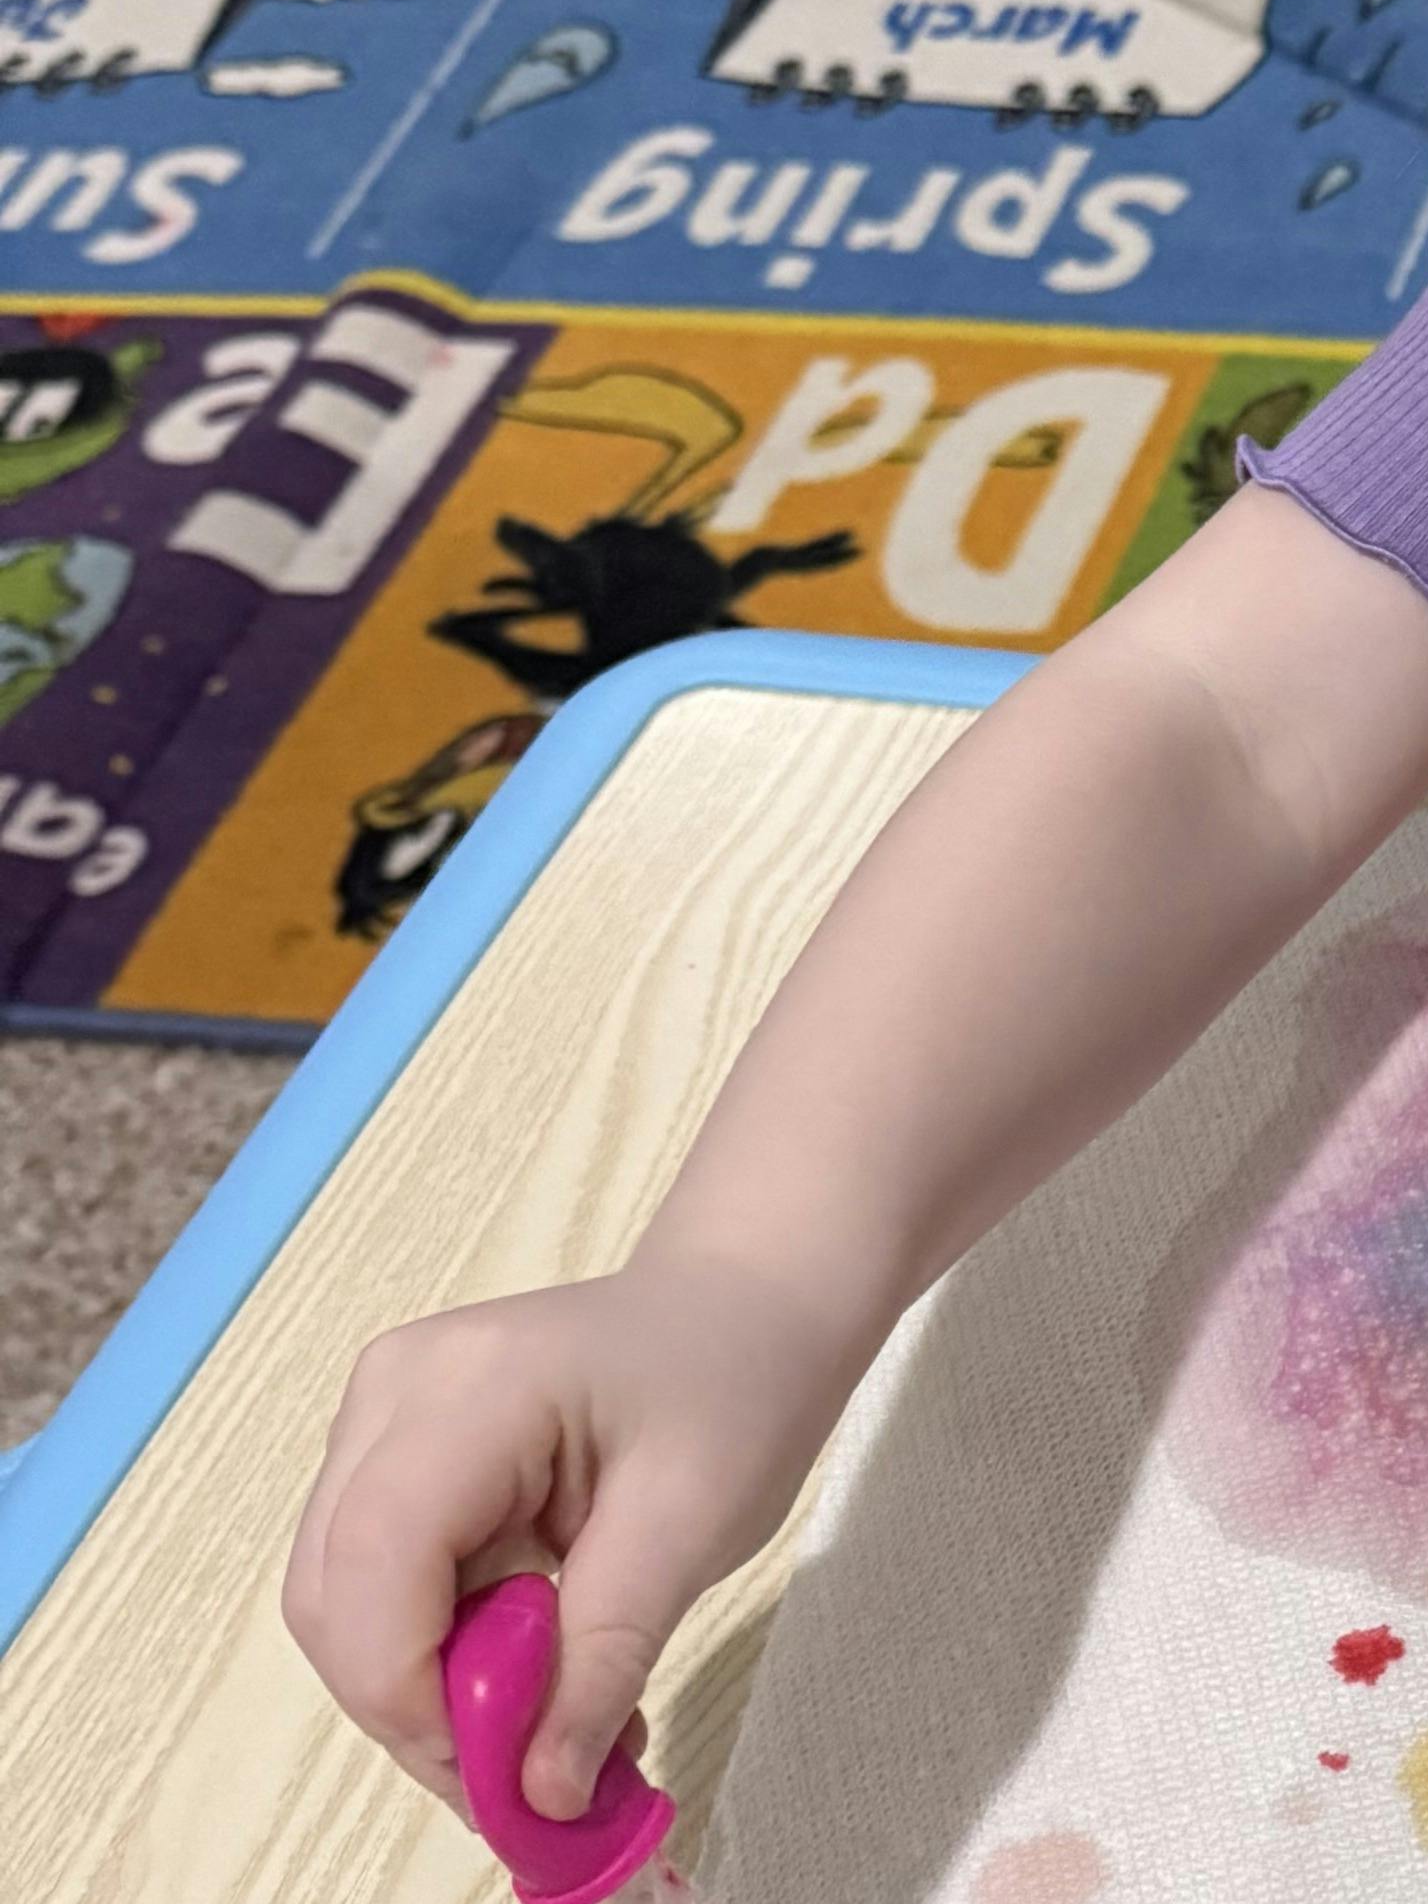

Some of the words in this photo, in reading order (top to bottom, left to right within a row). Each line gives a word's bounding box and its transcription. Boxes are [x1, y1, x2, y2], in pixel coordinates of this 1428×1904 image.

[0, 146, 246, 266] Su
[558, 125, 1192, 295] Spring
[140, 303, 516, 596] Ee
[714, 351, 1173, 635] Dd
